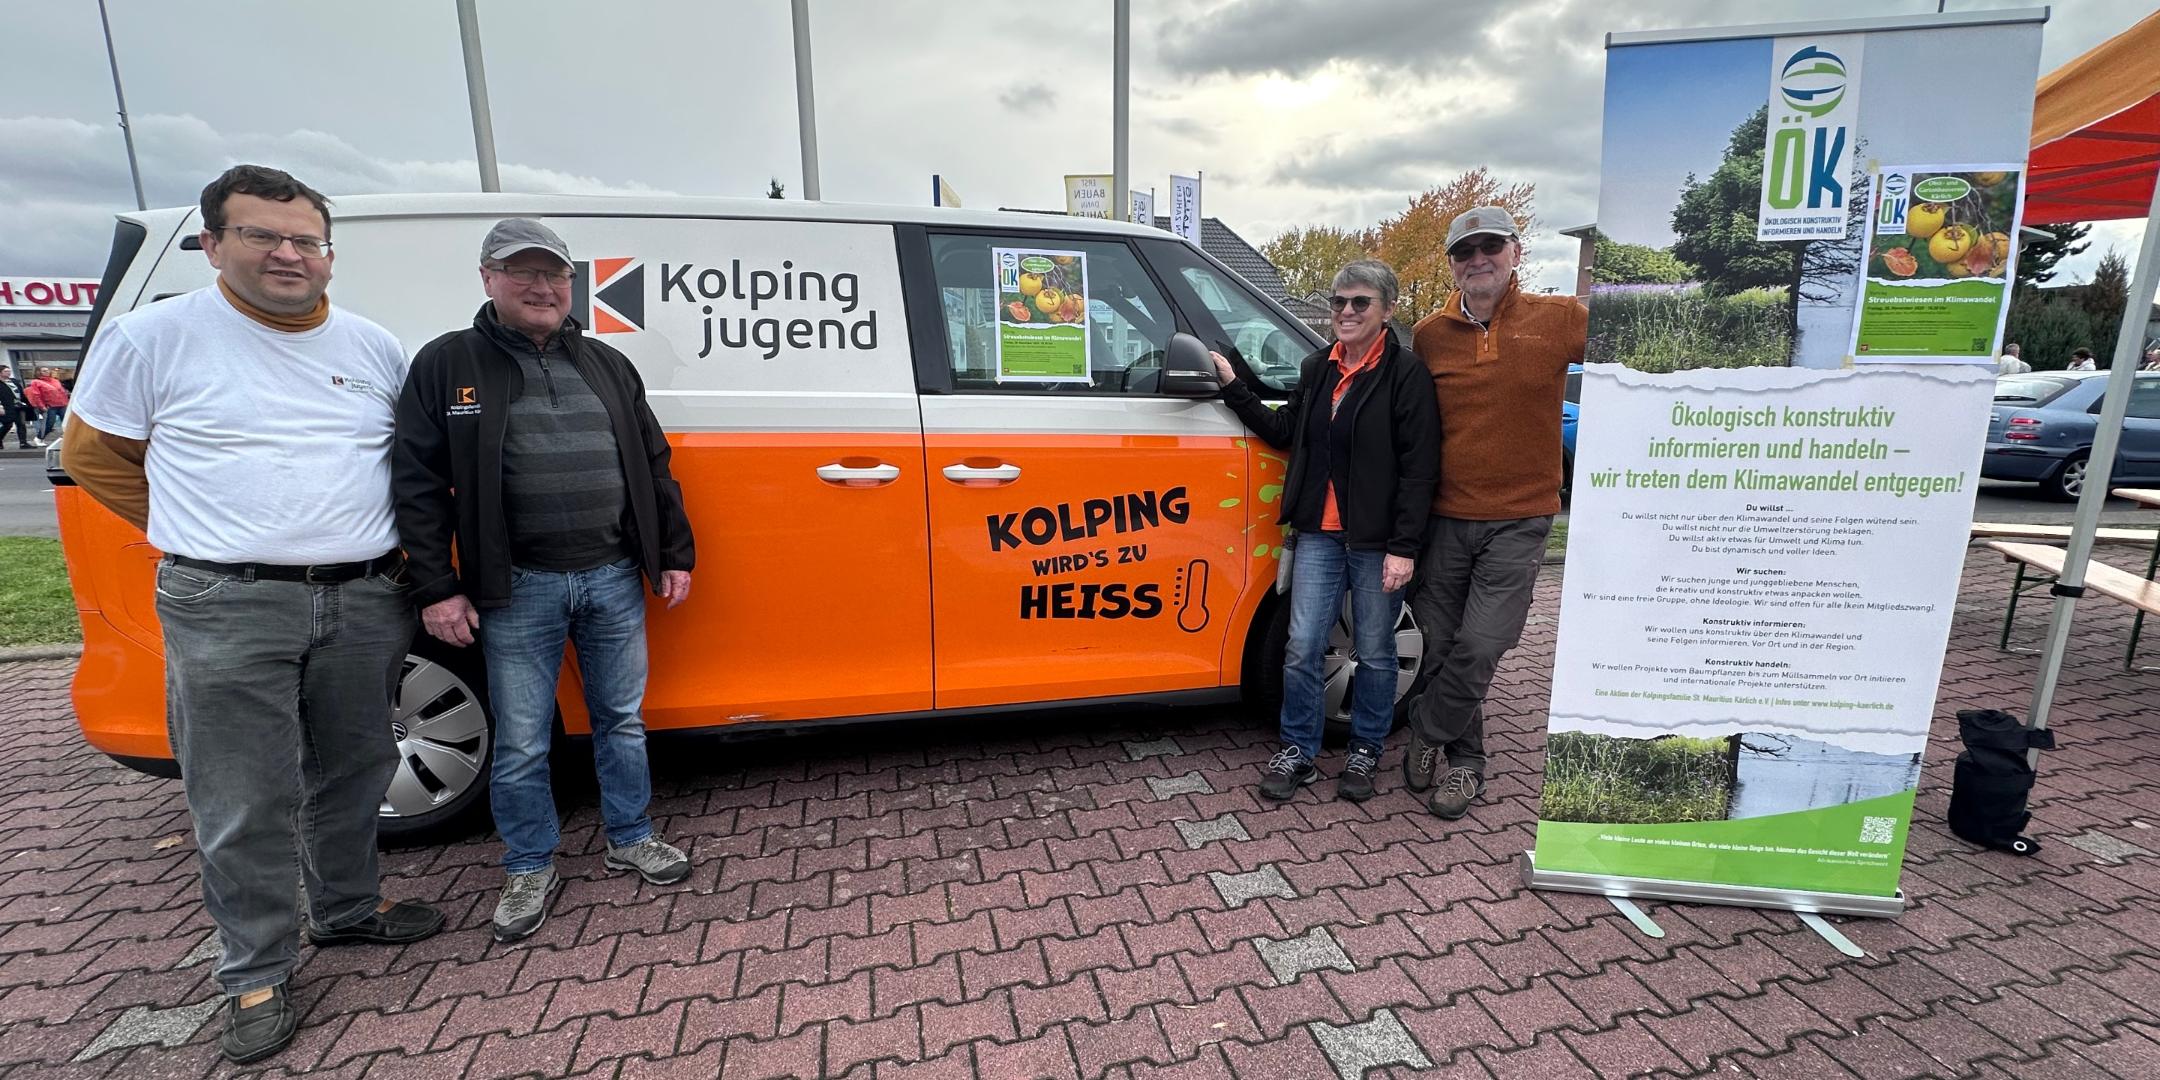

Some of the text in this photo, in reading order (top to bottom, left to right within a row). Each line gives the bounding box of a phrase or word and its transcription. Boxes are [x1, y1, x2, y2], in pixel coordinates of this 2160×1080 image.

[1768, 116, 1846, 210] ÖK
[1880, 194, 1906, 224] ÖK
[1765, 217, 1801, 225] ÖKOLOGISCH
[1762, 227, 1801, 236] INFORMIEREN
[661, 259, 858, 313] Kolping
[698, 304, 877, 360] jugend
[1672, 401, 1895, 433] Ökologisch konstruktiv
[1649, 436, 1888, 459] informieren und handeln
[1590, 468, 1966, 497] wir treten dem Klimawandel entgegen!
[1759, 504, 1783, 512] willst
[986, 486, 1190, 552] KOLPING
[1635, 512, 1657, 520] willst
[1659, 512, 1679, 520] nicht
[1697, 513, 1717, 521] über
[1719, 513, 1734, 521] den
[1736, 514, 1790, 522] Klimawandel
[1792, 515, 1809, 523] und
[1810, 515, 1833, 523] seine
[1835, 515, 1864, 525] Folgen
[1866, 516, 1898, 524] wütend
[1675, 524, 1697, 532] willst
[1753, 525, 1831, 535] Umweltzerstörung
[1682, 534, 1704, 542] willst
[1706, 534, 1726, 542] aktiv
[1728, 535, 1752, 543] etwas
[1768, 536, 1801, 544] Umwelt
[1803, 536, 1819, 544] und
[1821, 537, 1846, 545] Klima
[1722, 545, 1767, 555] dynamisch
[1786, 547, 1810, 555] voller
[1032, 544, 1147, 576] WIRD'S ZU
[1708, 576, 1731, 586] junge
[1750, 578, 1813, 588] junggebliebene
[1815, 579, 1860, 589] Menschen,
[1717, 587, 1763, 595] konstruktiv
[1765, 588, 1790, 596] etwas
[1791, 589, 1831, 599] anpacken
[1020, 583, 1163, 619] HEISS
[1827, 600, 1842, 608] alle
[1702, 618, 1806, 628] Konstruktiv informieren:
[1705, 628, 1751, 636] konstruktiv
[1791, 631, 1844, 640] Klimawandel
[1670, 636, 1698, 646] Folgen
[1700, 637, 1750, 646] informieren.
[1826, 642, 1857, 652] Region.
[1705, 658, 1791, 668] Konstruktiv handeln:
[1607, 663, 1633, 671] wollen
[1635, 664, 1668, 674] Projekte
[1689, 666, 1746, 677] Baumpflanzen
[1781, 670, 1837, 680] Müllsammeln
[1680, 677, 1736, 686] internationale
[1738, 679, 1772, 689] Projekte
